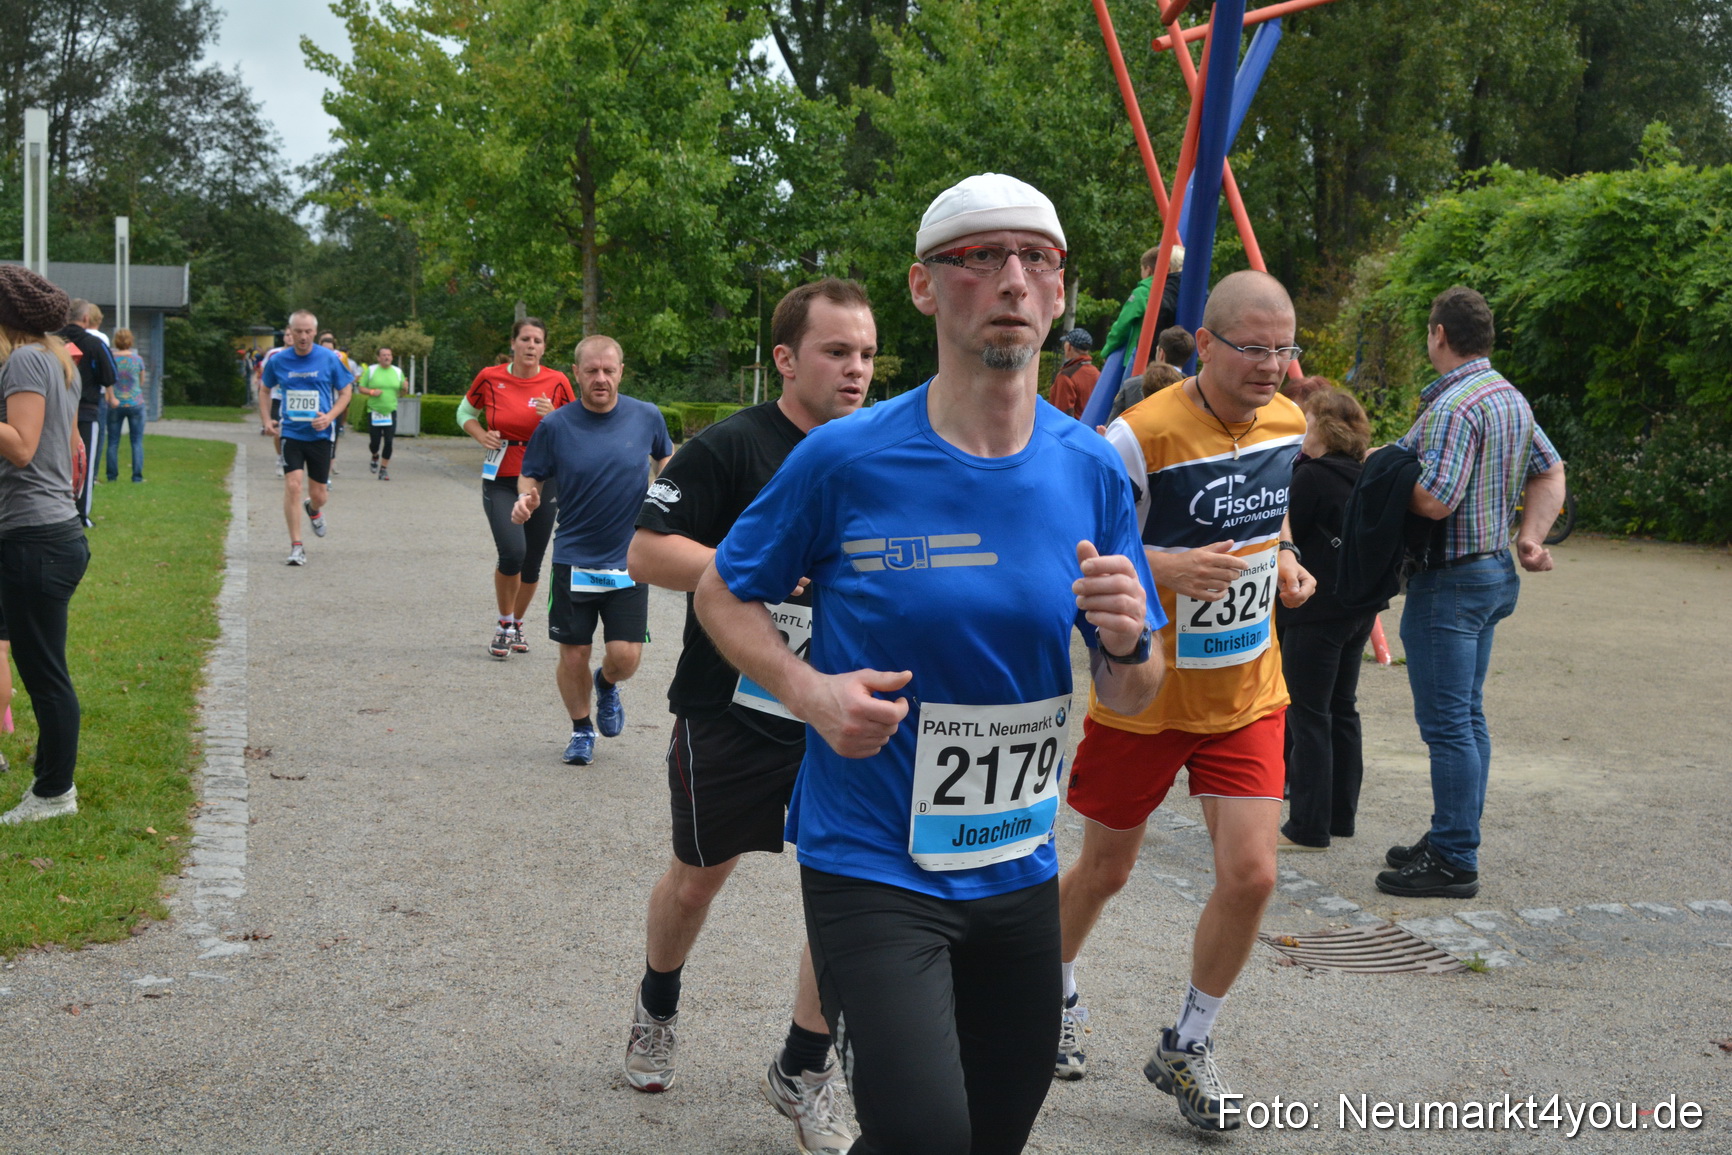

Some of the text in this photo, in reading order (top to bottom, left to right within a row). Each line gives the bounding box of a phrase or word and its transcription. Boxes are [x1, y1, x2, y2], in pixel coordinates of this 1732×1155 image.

[289, 398, 316, 409] 2709
[1213, 486, 1290, 518] Fischer
[590, 575, 616, 586] Stefan
[1239, 562, 1268, 578] markt
[1190, 575, 1271, 627] 2324
[771, 611, 804, 629] ARTL
[1203, 630, 1262, 654] Christian
[922, 716, 1053, 737] PARTL Neumarkt
[932, 736, 1058, 806] 2179
[919, 802, 927, 813] D
[951, 817, 1032, 847] Joachim
